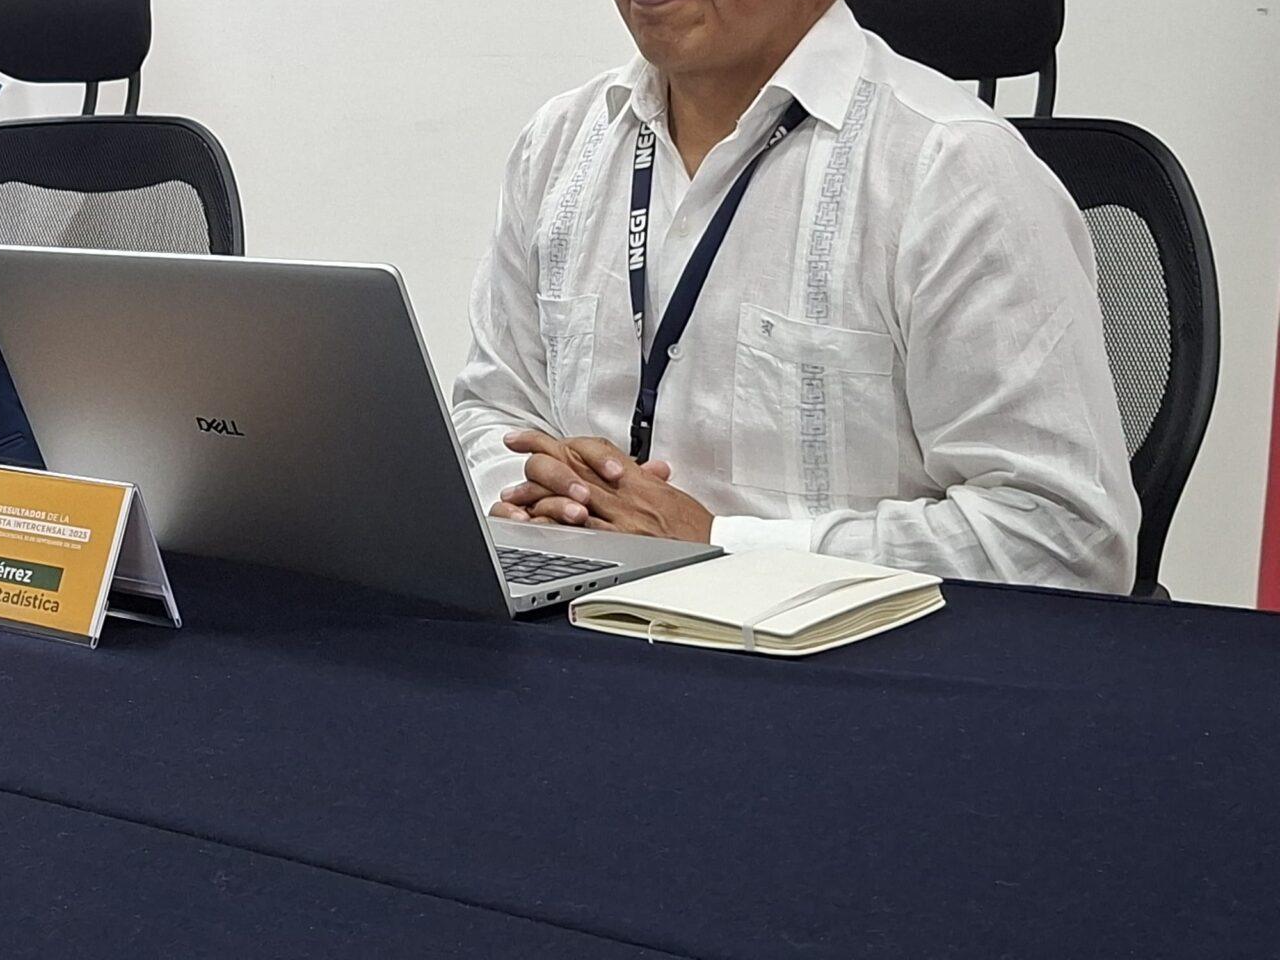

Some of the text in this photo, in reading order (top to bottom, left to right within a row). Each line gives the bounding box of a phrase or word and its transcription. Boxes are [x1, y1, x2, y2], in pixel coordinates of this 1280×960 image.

[629, 208, 647, 270] INEGI
[196, 417, 245, 436] DELL
[59, 513, 70, 523] LA
[13, 519, 66, 536] INTERCENSAL
